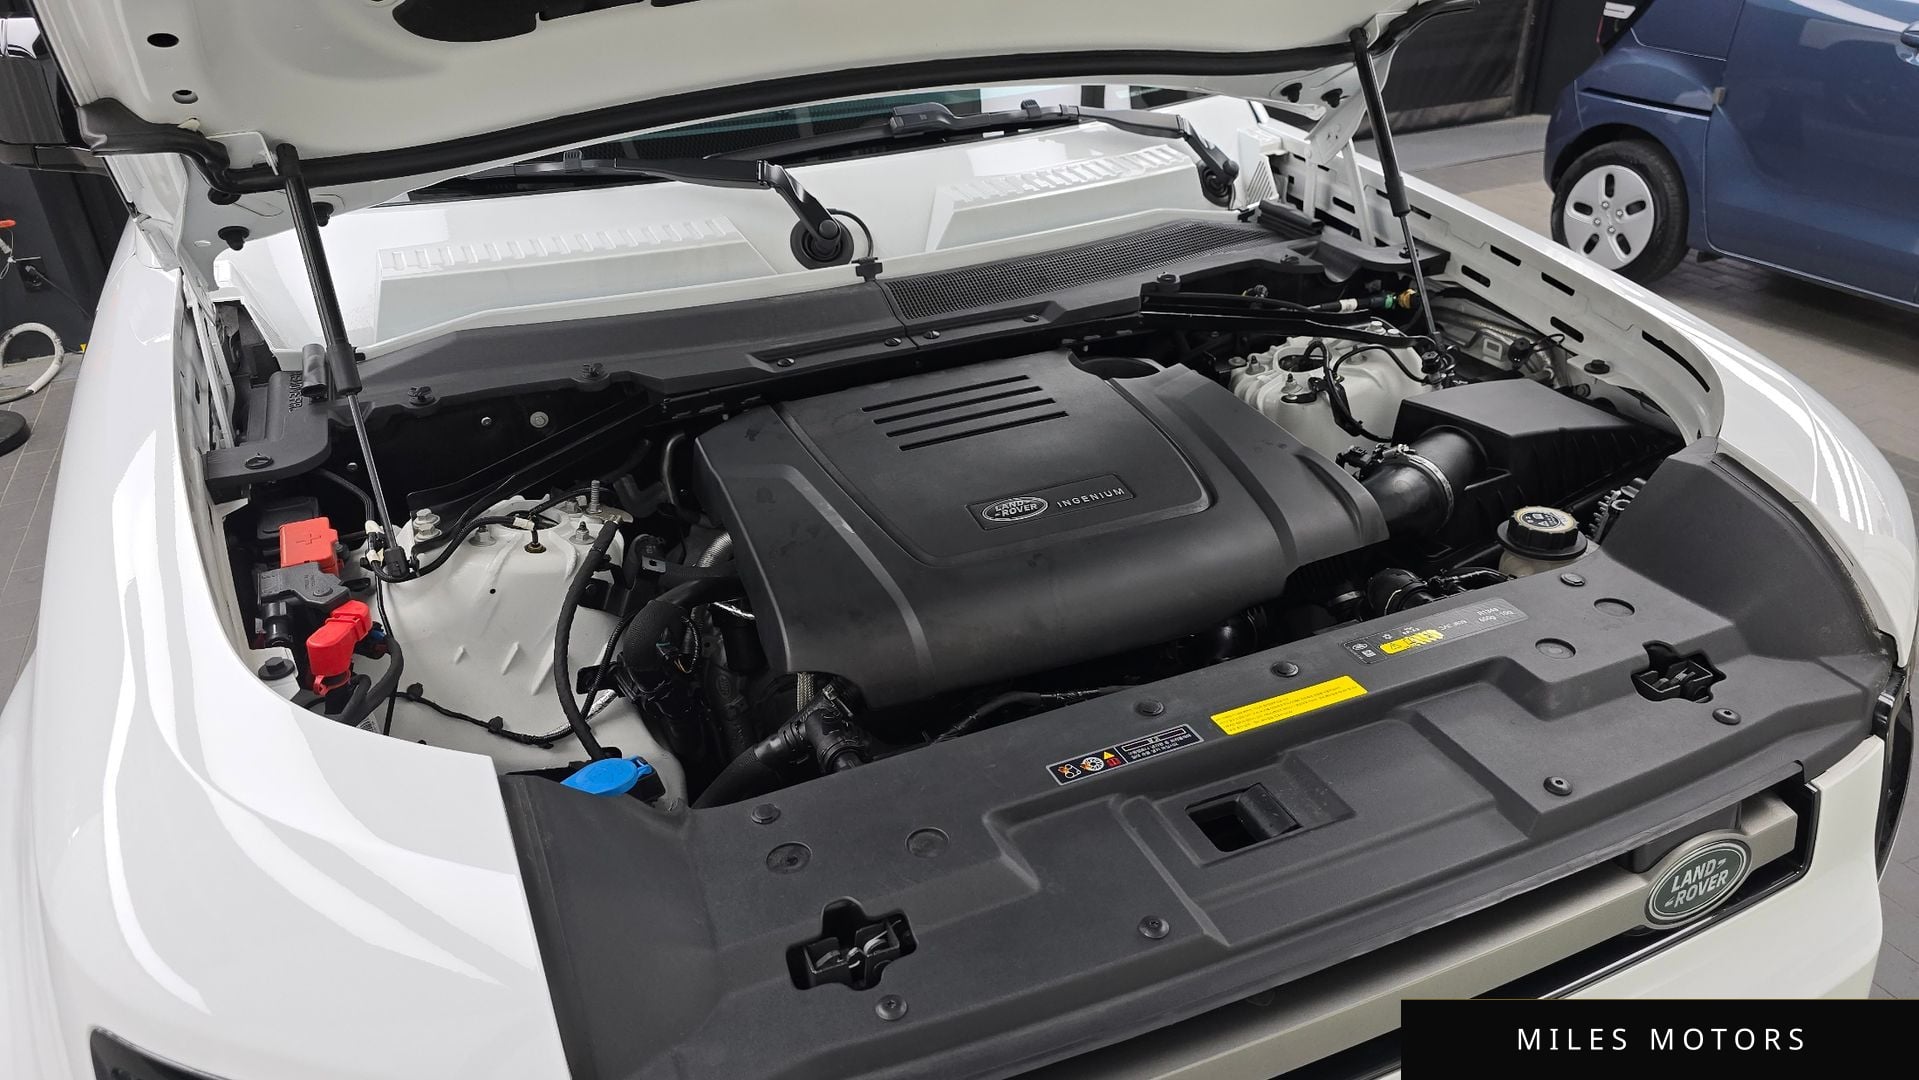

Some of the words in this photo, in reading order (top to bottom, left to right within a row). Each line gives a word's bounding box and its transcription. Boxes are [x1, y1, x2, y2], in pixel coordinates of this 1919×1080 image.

[995, 500, 1025, 512] LAND
[1057, 487, 1125, 508] INGENIUM
[1001, 503, 1038, 517] ROVER
[1671, 858, 1717, 893] LAND
[1674, 869, 1729, 908] ROVER
